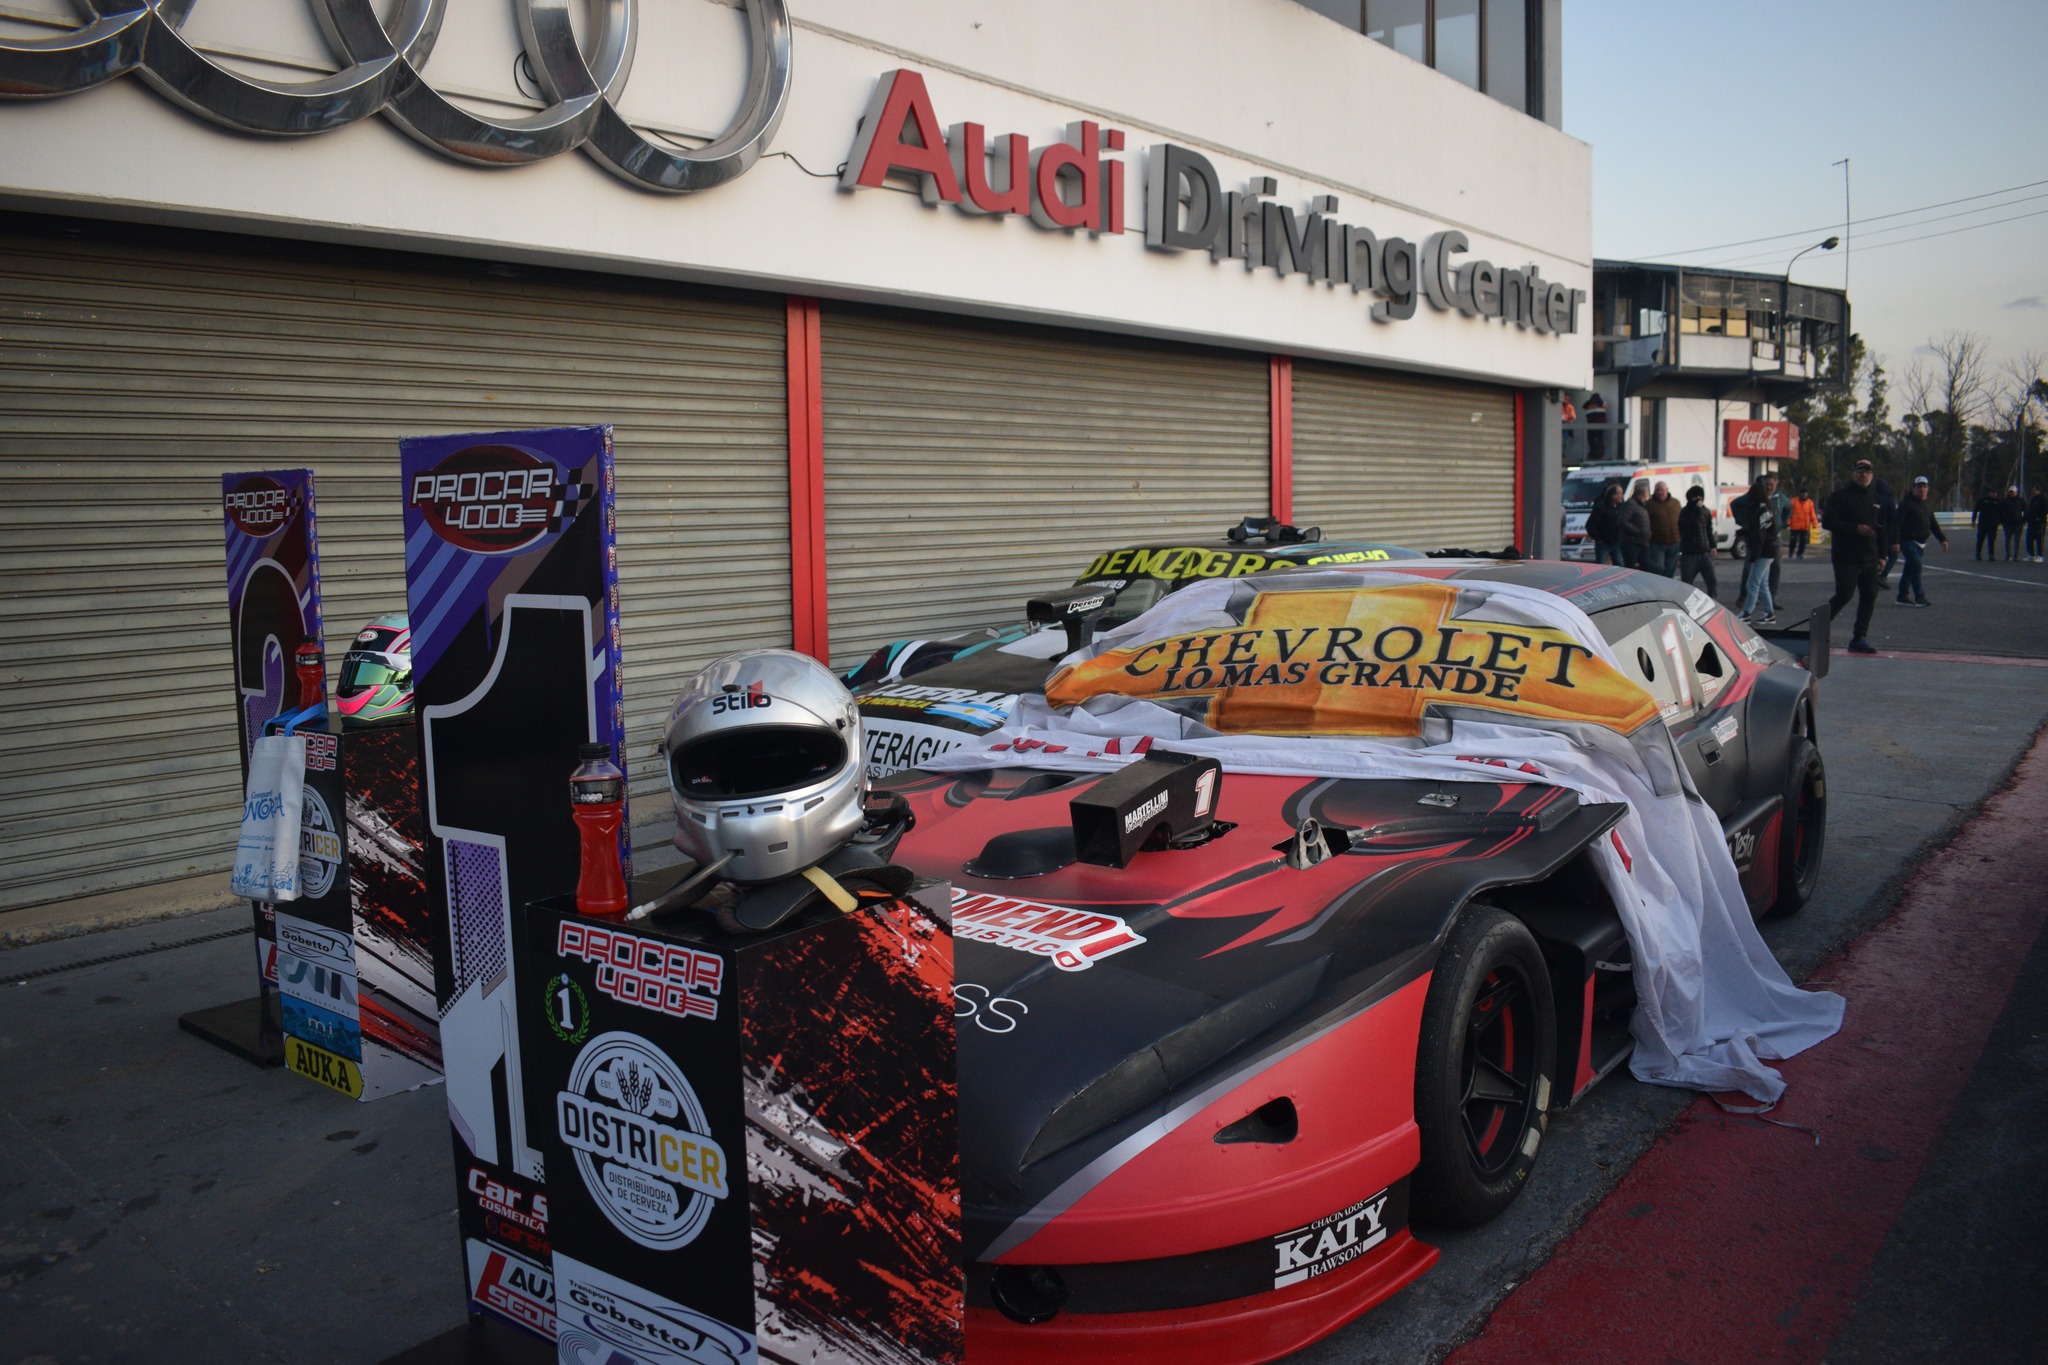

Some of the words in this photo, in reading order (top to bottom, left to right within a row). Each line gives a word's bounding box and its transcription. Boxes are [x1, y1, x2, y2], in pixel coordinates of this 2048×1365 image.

[848, 68, 1125, 236] Audi
[1147, 143, 1417, 321] Driving
[1422, 229, 1586, 334] Center
[225, 489, 286, 510] PROCAR
[410, 467, 554, 504] PROCAR
[240, 509, 278, 524] 4000
[445, 503, 540, 530] 4000
[1125, 626, 1593, 688] CHEVROLET
[1660, 619, 1693, 706] 1
[1160, 662, 1310, 692] LOMAS
[1318, 662, 1521, 701] GRANDE
[1124, 788, 1169, 825] MARTELLINI
[1194, 768, 1217, 818] 1
[282, 930, 330, 953] Gobetto
[558, 922, 722, 993] PROCAR
[597, 964, 700, 1018] 4000
[295, 1042, 352, 1093] AUKA
[600, 1079, 613, 1090] EST.
[657, 1097, 673, 1110] 1970
[563, 1100, 722, 1189] DISTRICER
[468, 1167, 522, 1209] Car
[609, 1171, 673, 1205] DISTRIBUIDORA
[617, 1187, 628, 1200] DE
[630, 1191, 669, 1216] CERVEZA
[478, 1196, 547, 1234] COSMETICA
[1311, 1200, 1364, 1230] CHACINADOS
[1275, 1196, 1388, 1274] KATY
[1310, 1242, 1363, 1278] RAWSON
[569, 1279, 616, 1304] Transporte
[569, 1289, 691, 1352] Gobetto
